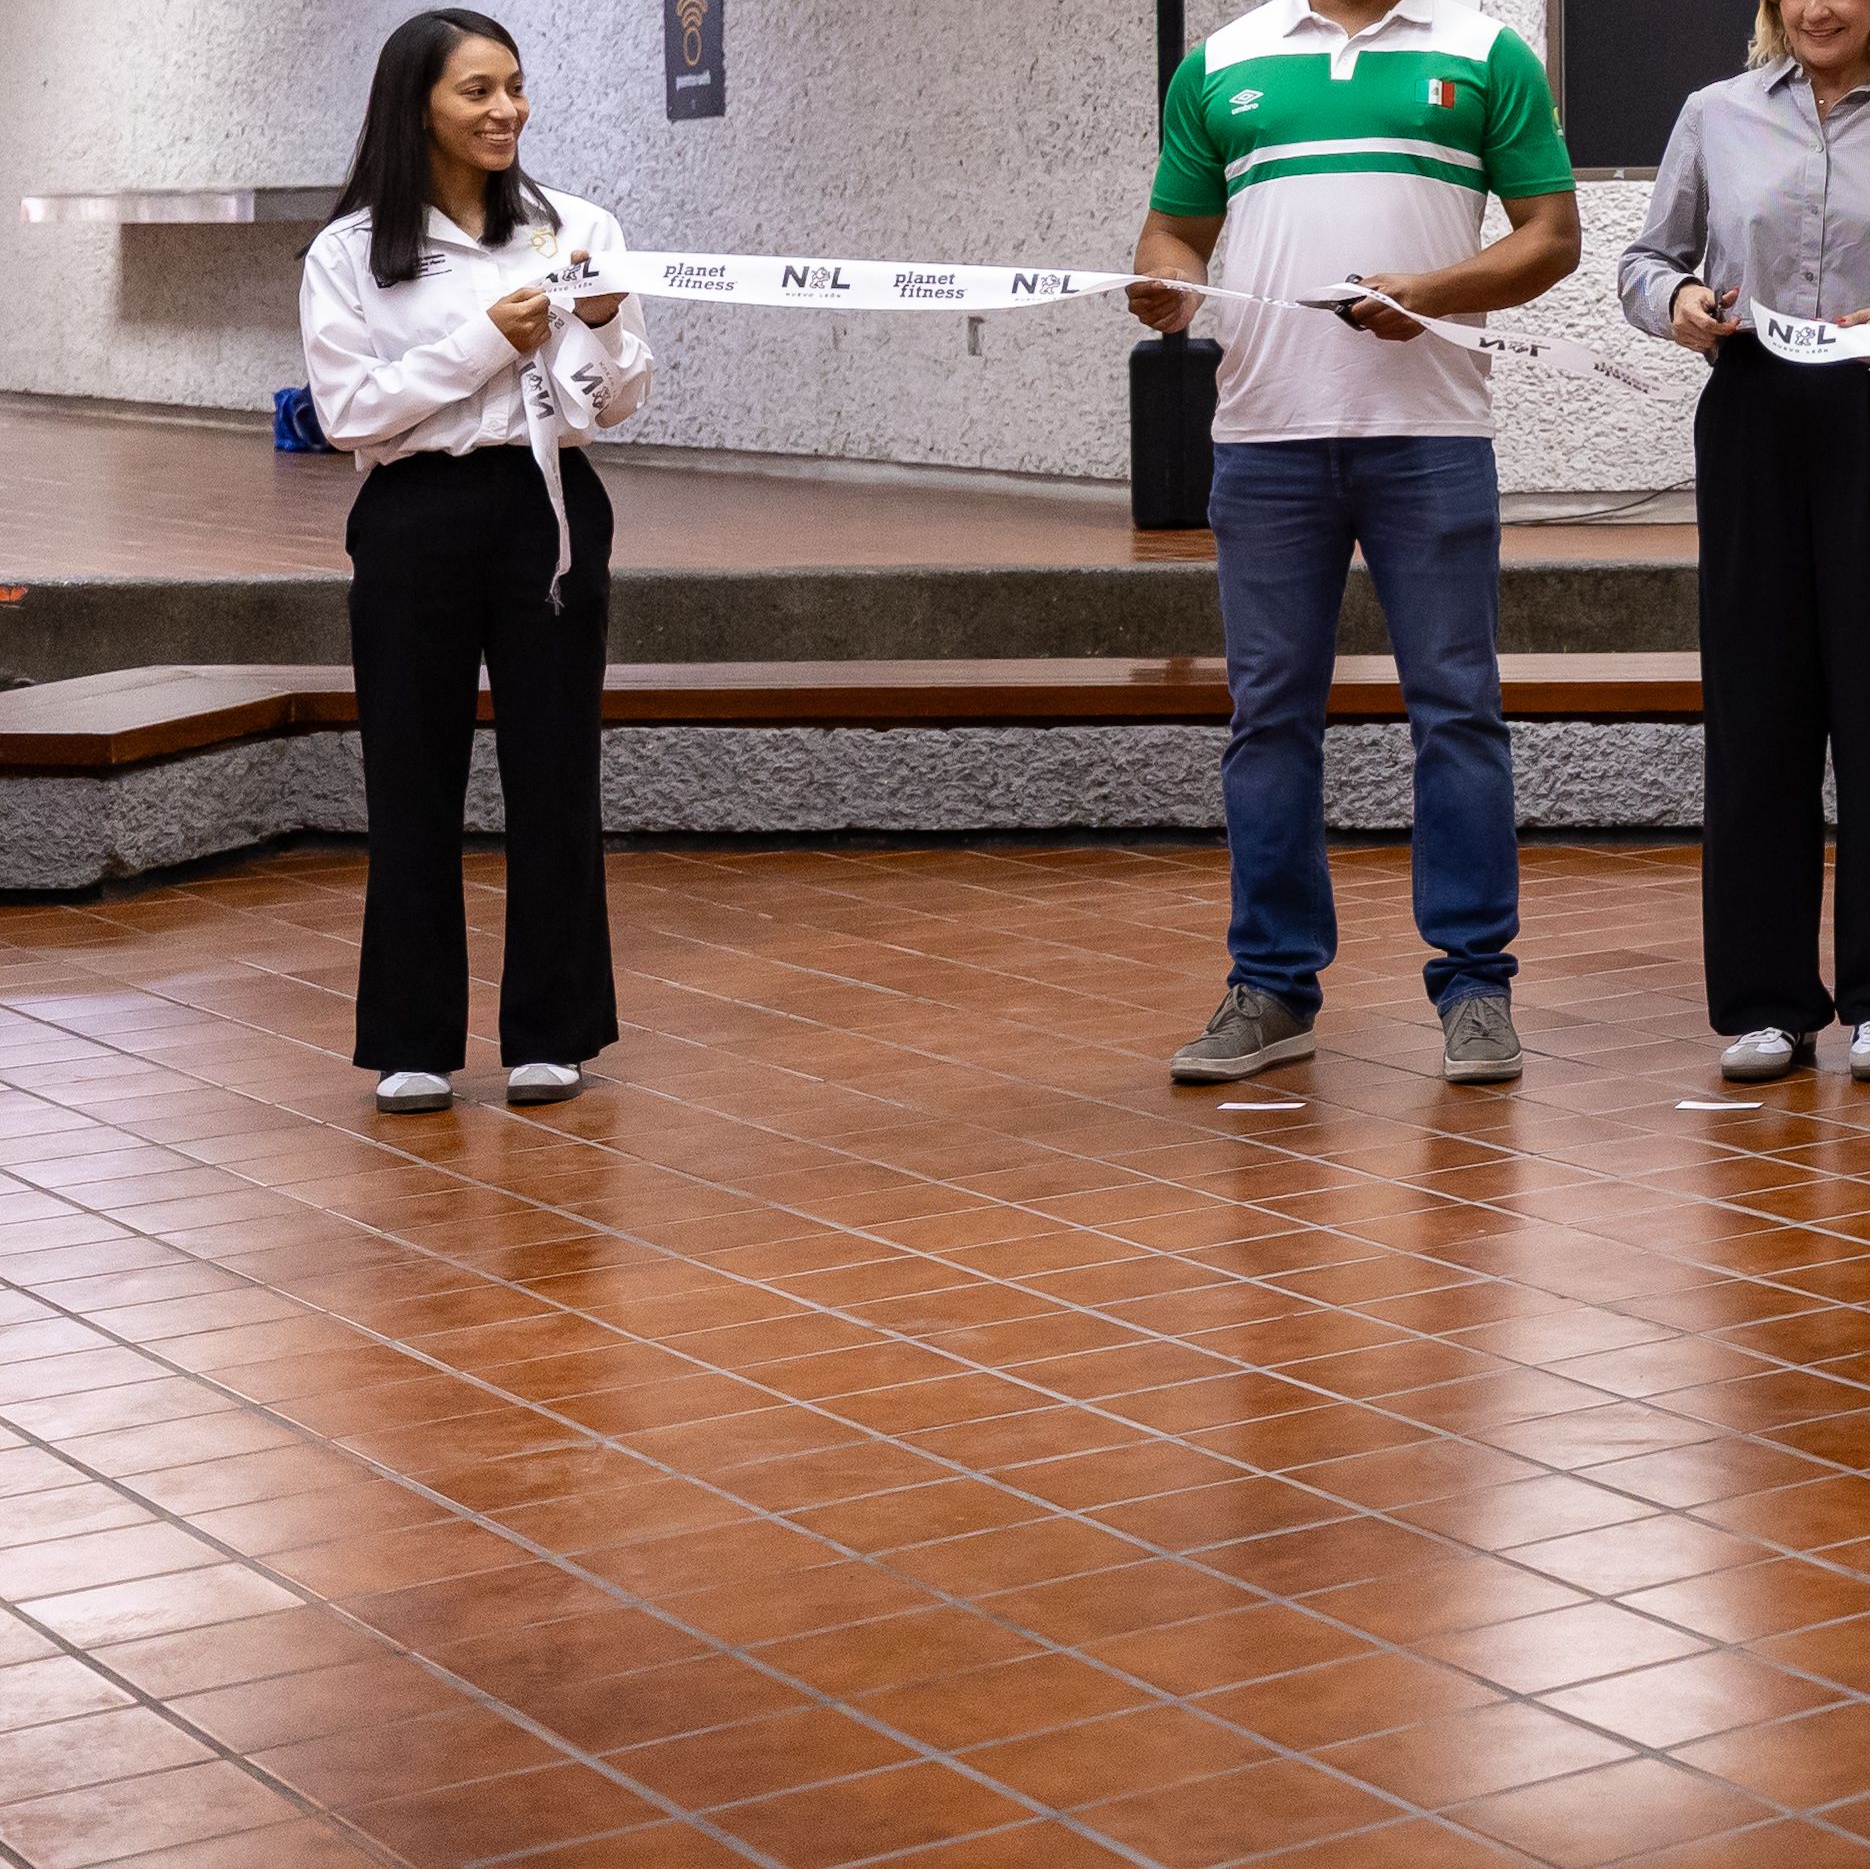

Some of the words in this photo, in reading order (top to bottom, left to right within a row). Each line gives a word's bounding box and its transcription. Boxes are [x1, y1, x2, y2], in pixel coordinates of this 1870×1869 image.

[663, 263, 726, 278] planet
[668, 275, 736, 291] fitness
[893, 271, 955, 287] planet
[899, 284, 966, 299] fitness
